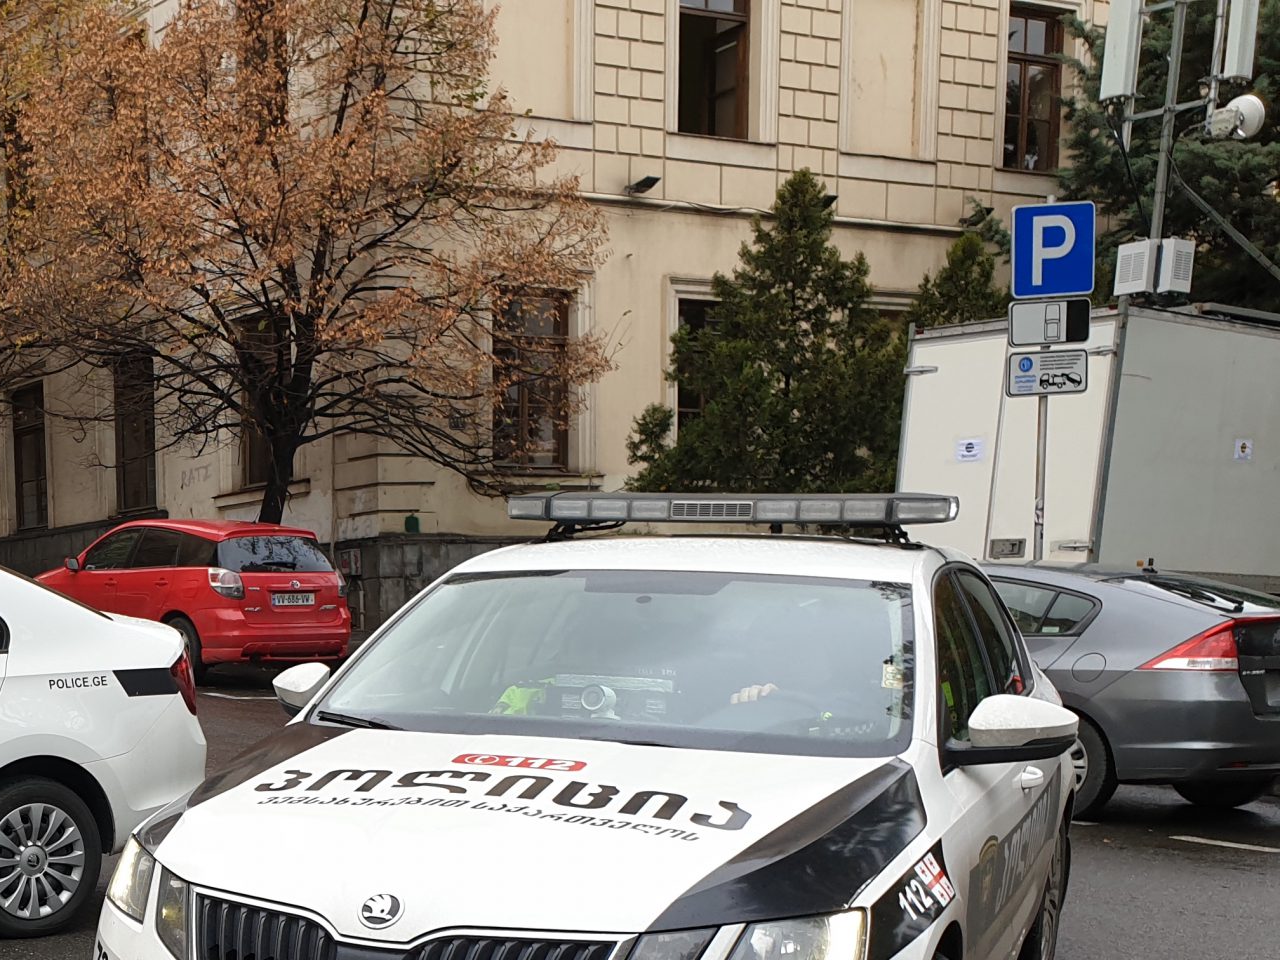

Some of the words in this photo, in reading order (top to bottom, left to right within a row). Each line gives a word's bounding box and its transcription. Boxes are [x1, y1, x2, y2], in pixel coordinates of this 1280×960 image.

[1032, 215, 1076, 286] P
[48, 676, 108, 690] POLICE.GE
[503, 756, 576, 772] 112
[253, 769, 753, 831] პოლიცია
[257, 796, 471, 810] ვემსახურებით
[470, 801, 701, 842] საქართველოს
[898, 879, 934, 921] 112
